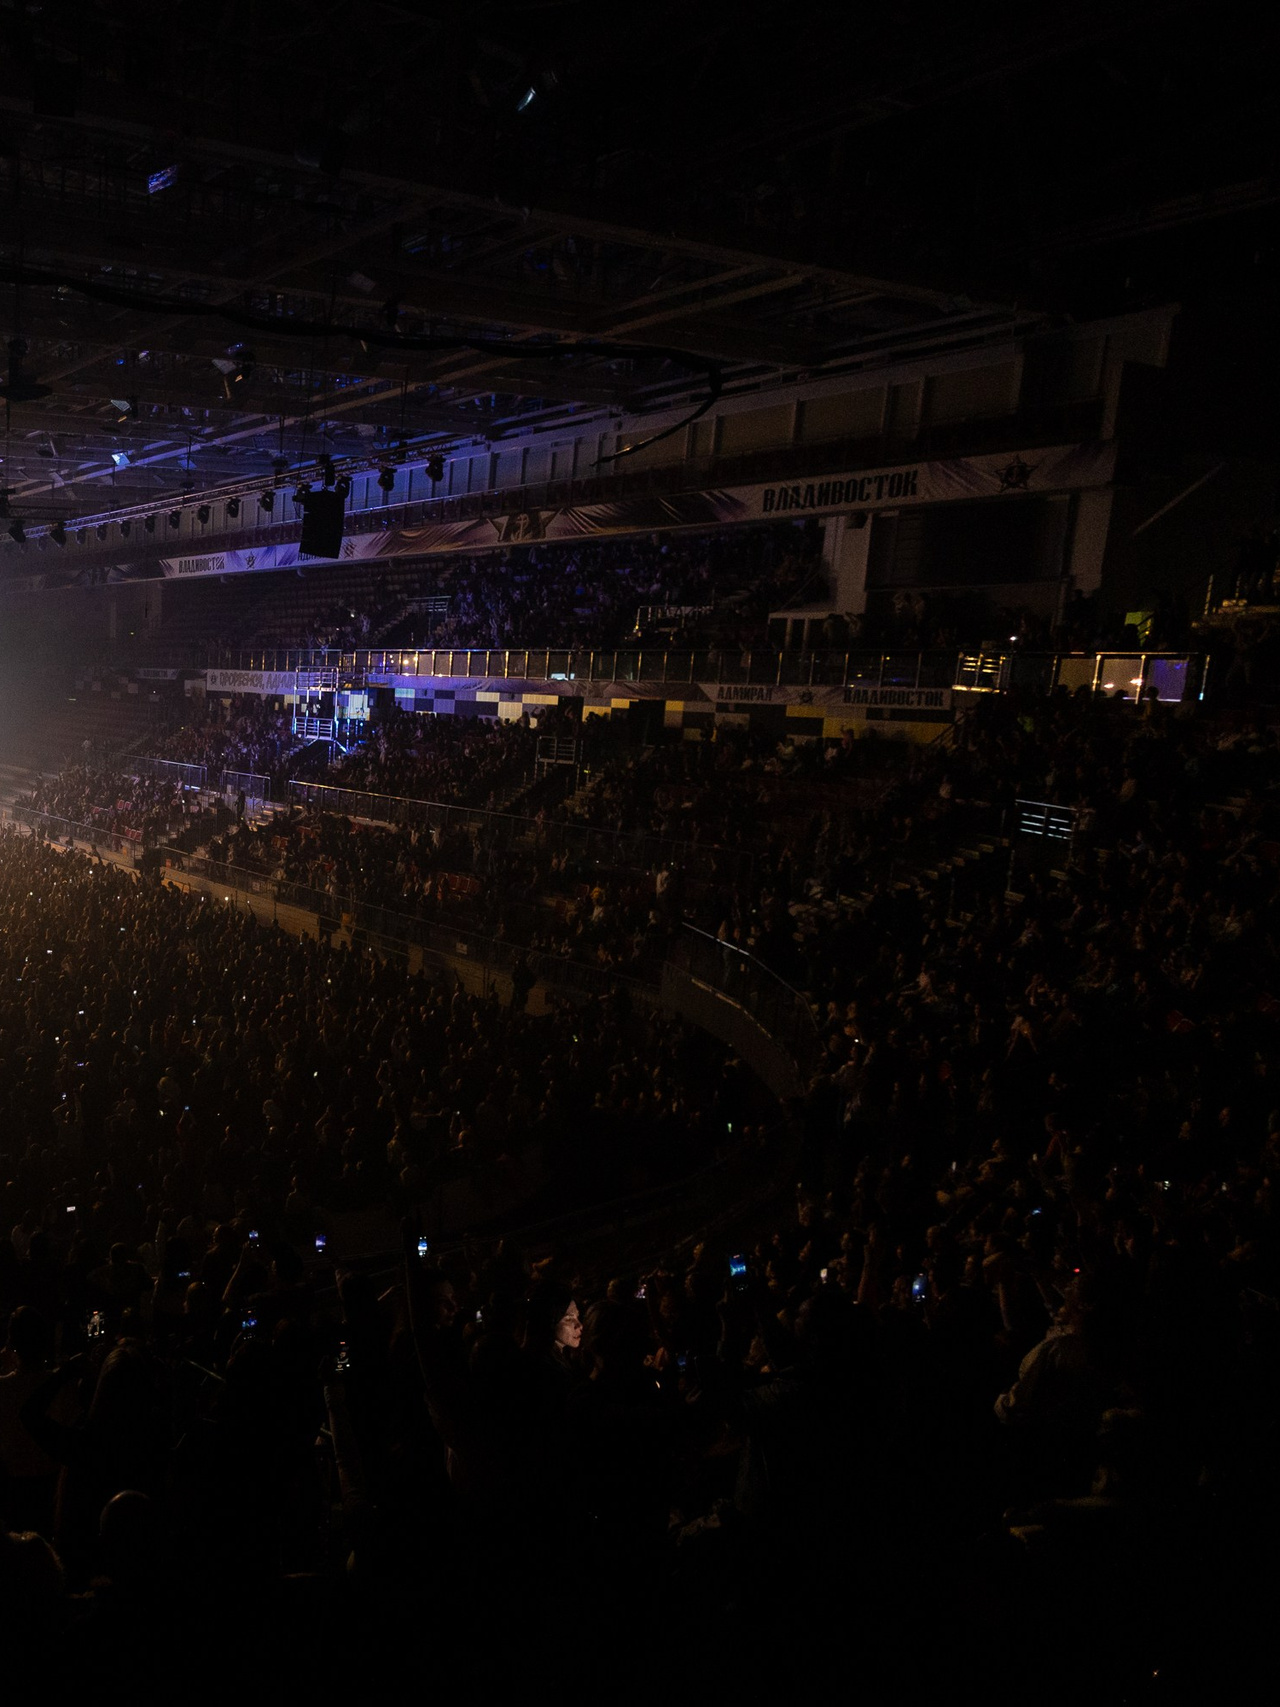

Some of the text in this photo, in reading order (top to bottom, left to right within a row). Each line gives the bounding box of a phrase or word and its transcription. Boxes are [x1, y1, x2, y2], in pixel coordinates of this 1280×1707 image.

[762, 469, 919, 513] ВЛАДИВОСТОК
[717, 686, 944, 706] АДМИРАЛ ВЛАДИВОСТОК
